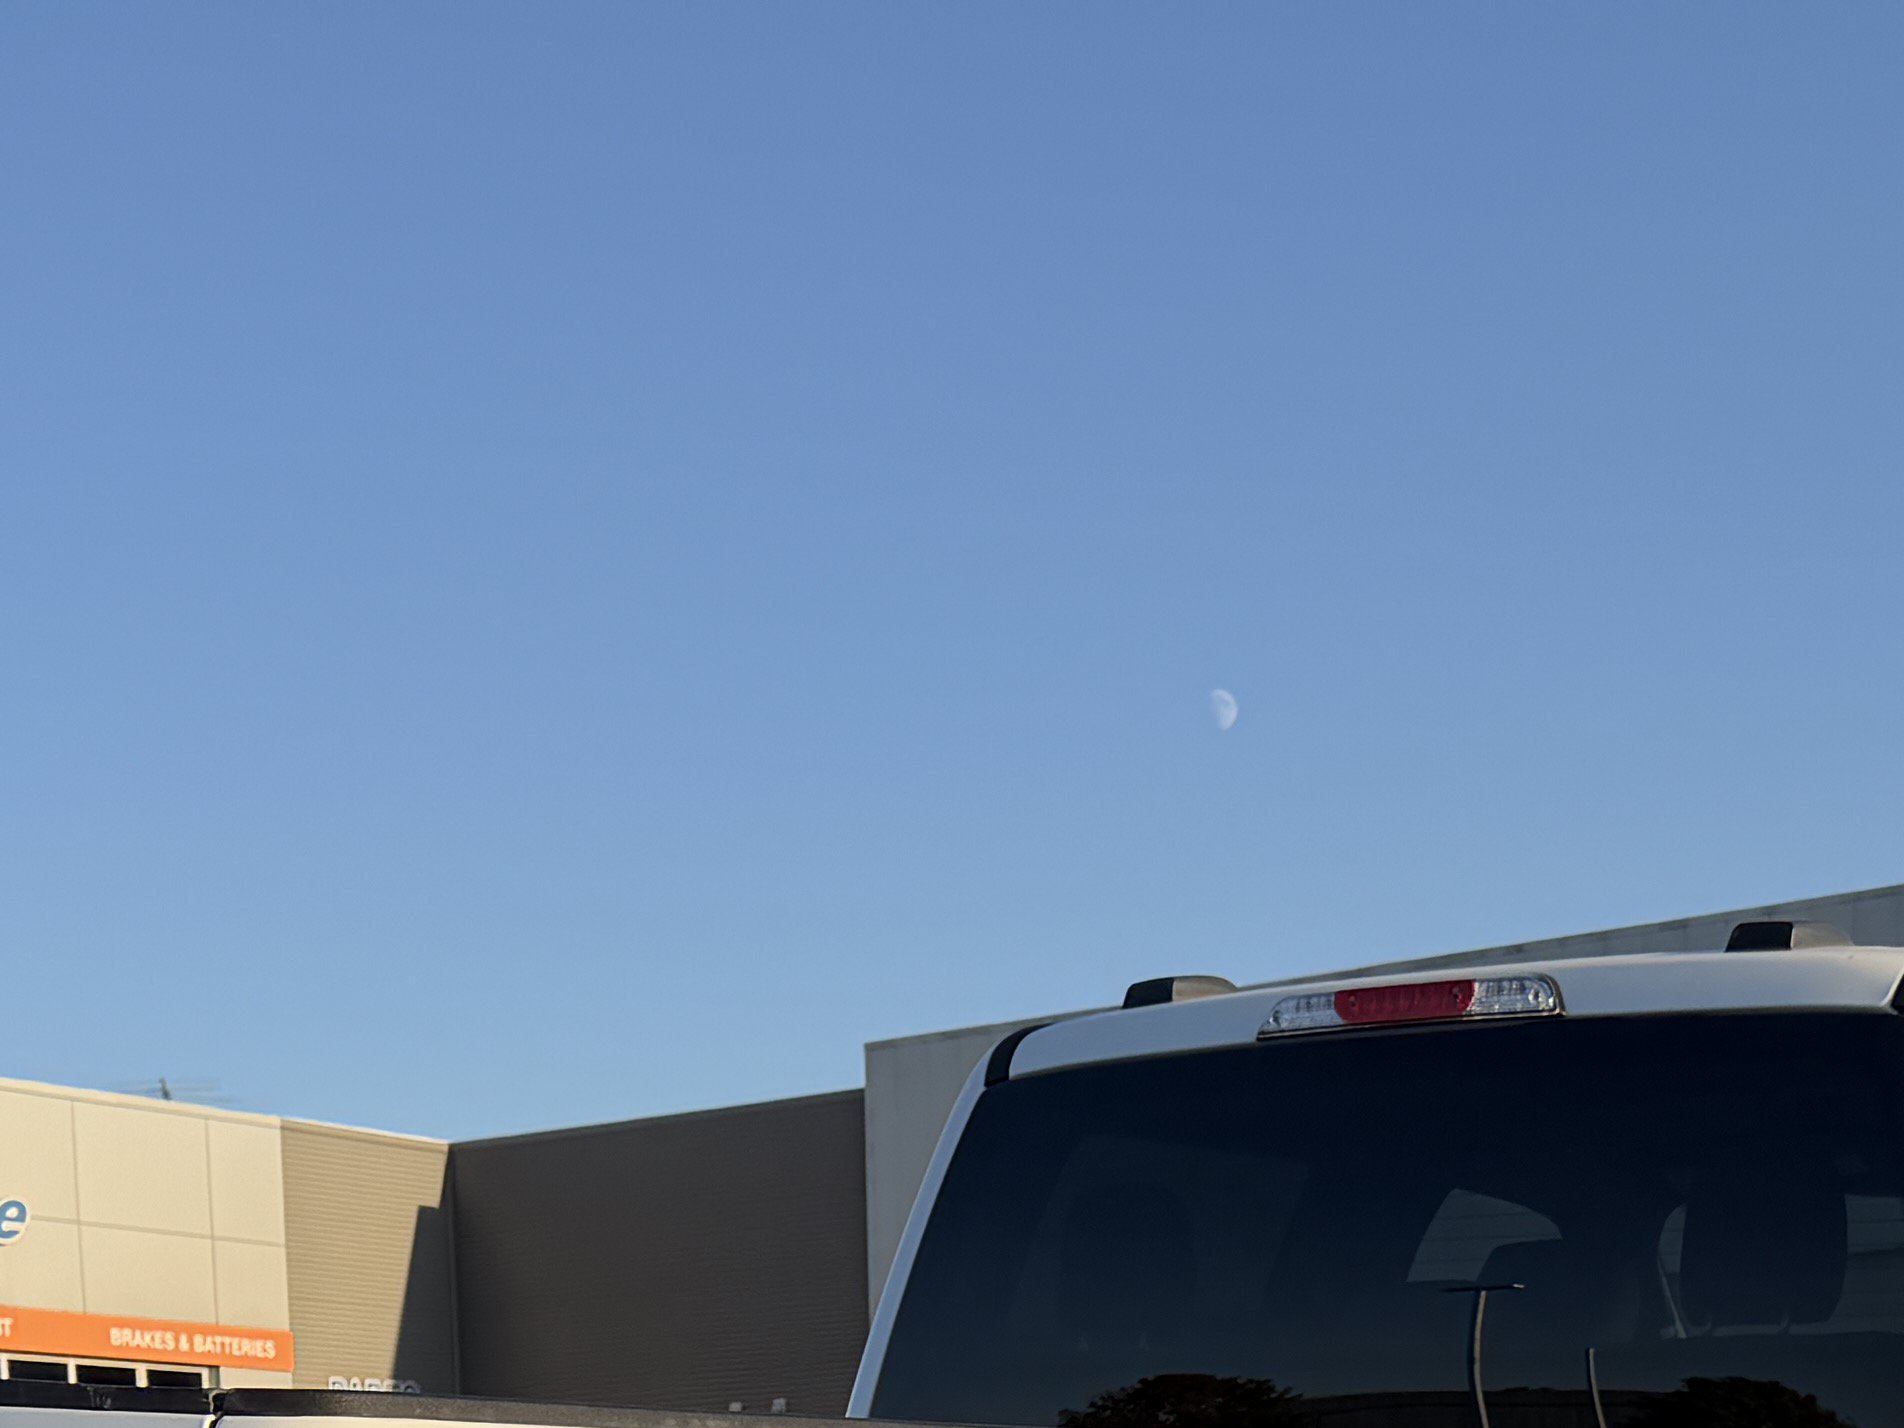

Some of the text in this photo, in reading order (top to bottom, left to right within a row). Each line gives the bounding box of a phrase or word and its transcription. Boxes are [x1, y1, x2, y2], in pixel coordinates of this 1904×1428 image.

[109, 1327, 277, 1359] BRAKES & BATTERIES
